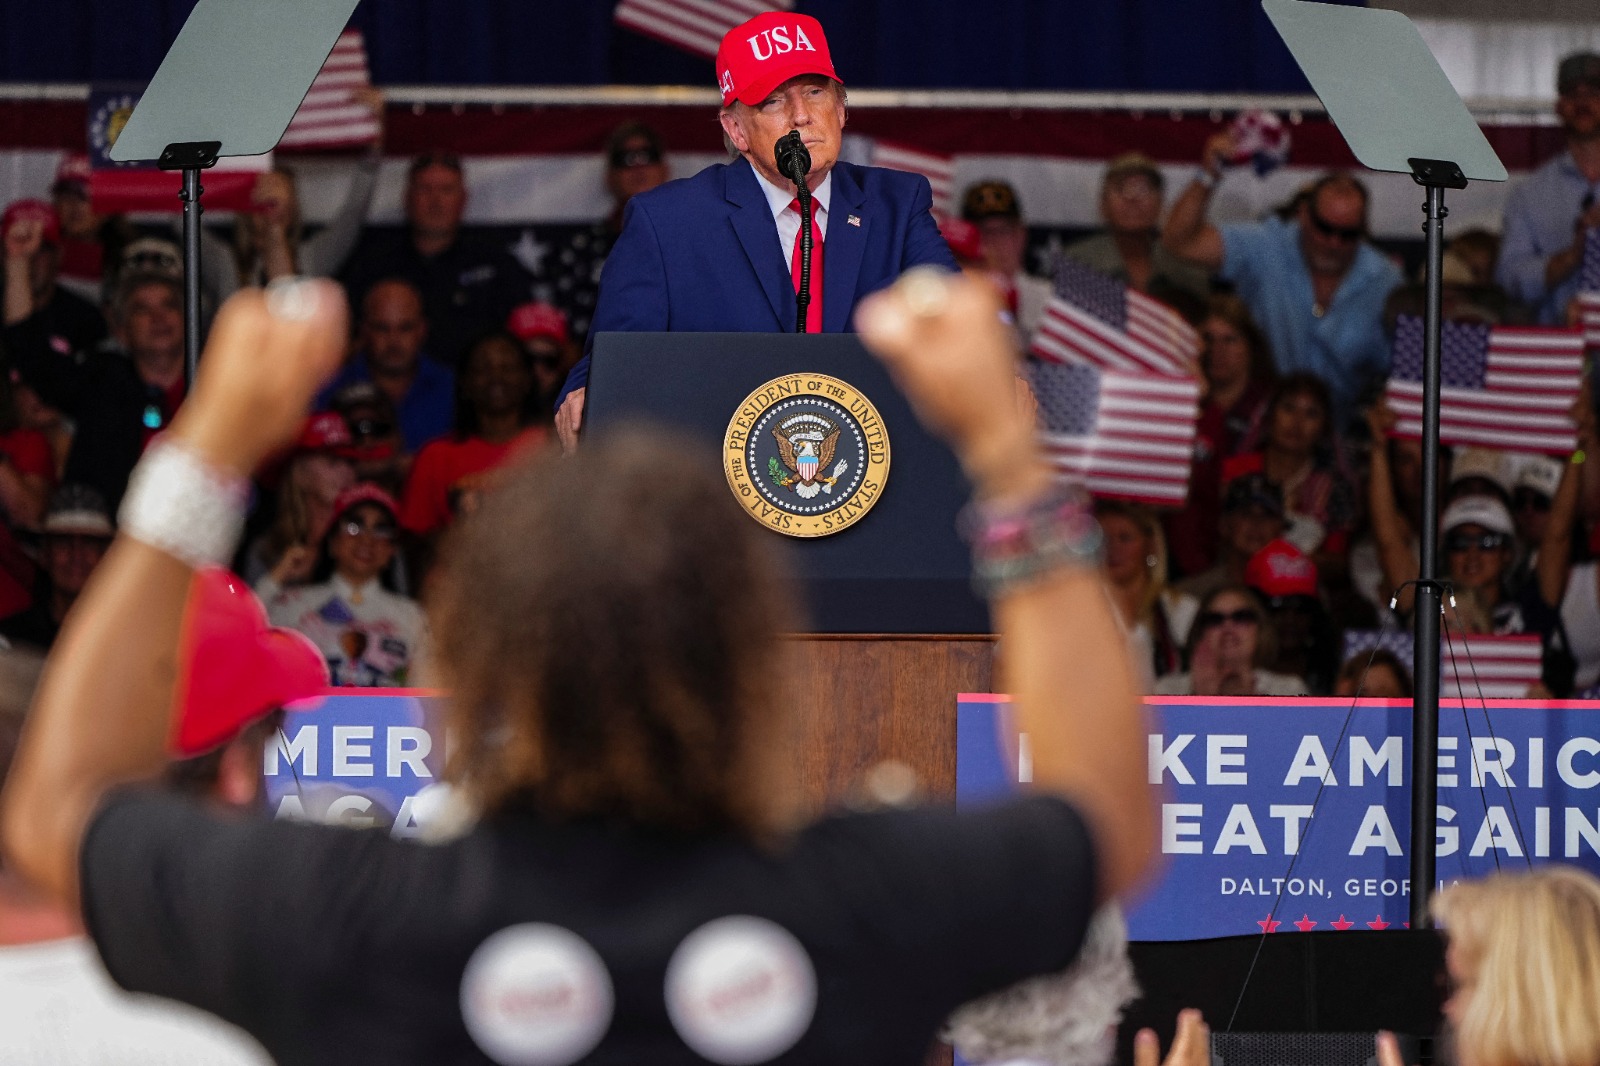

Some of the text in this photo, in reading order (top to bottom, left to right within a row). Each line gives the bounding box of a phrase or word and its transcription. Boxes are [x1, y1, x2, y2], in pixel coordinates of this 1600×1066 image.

[747, 24, 816, 61] USA
[806, 381, 823, 391] OF
[826, 384, 847, 400] THE
[729, 379, 802, 452] PRESIDENT
[850, 397, 885, 465] UNITED
[731, 457, 742, 481] THE
[738, 483, 751, 497] OF
[822, 479, 878, 529] STATES
[751, 494, 793, 529] SEAL
[264, 725, 453, 778] MER
[1348, 805, 1600, 858] AGAIN
[1221, 878, 1460, 899] DALTON, GEORI
